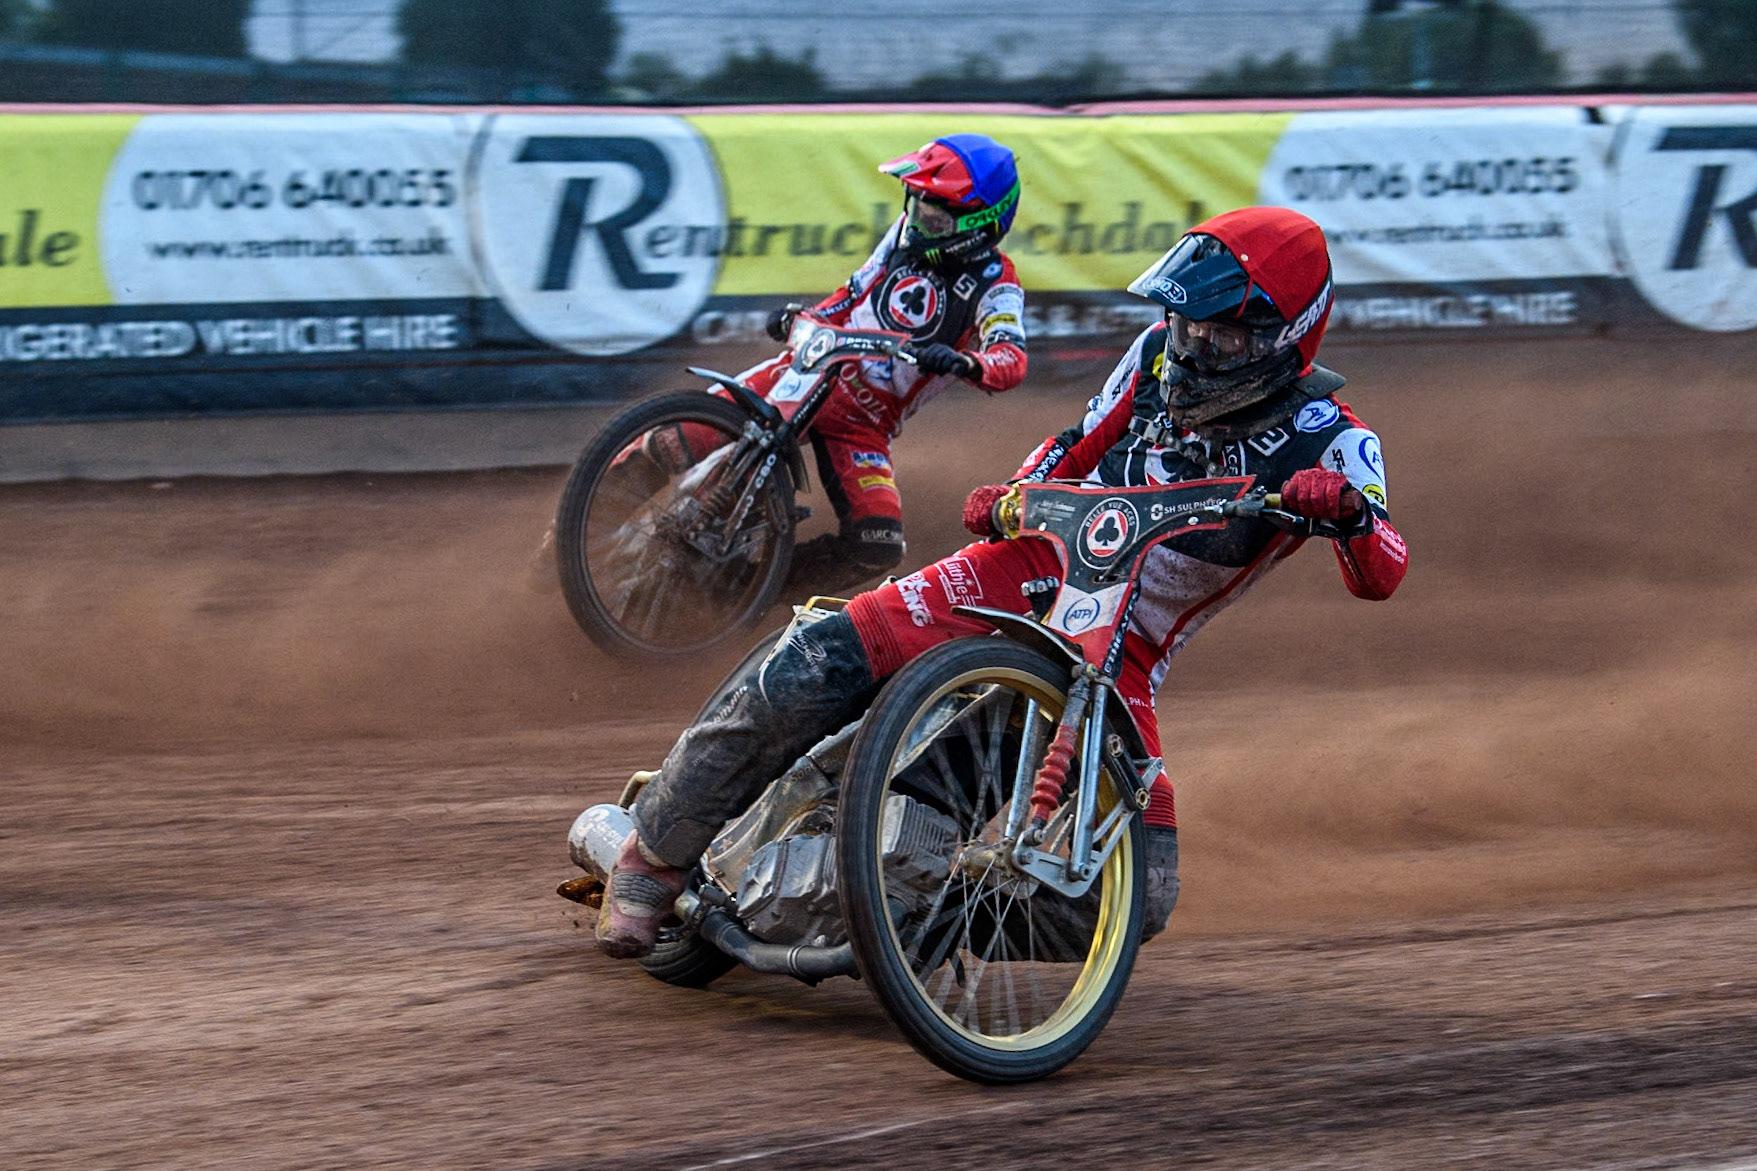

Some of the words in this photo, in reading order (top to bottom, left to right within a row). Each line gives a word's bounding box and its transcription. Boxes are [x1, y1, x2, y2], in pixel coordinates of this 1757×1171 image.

[131, 168, 273, 210] 01706
[281, 167, 457, 210] 640055
[1282, 162, 1412, 201] 01706
[1420, 156, 1580, 197] 640055
[0, 209, 80, 267] le
[198, 316, 362, 356] VEHICLE
[363, 313, 460, 350] HIRE
[1067, 608, 1095, 621] ATPI
